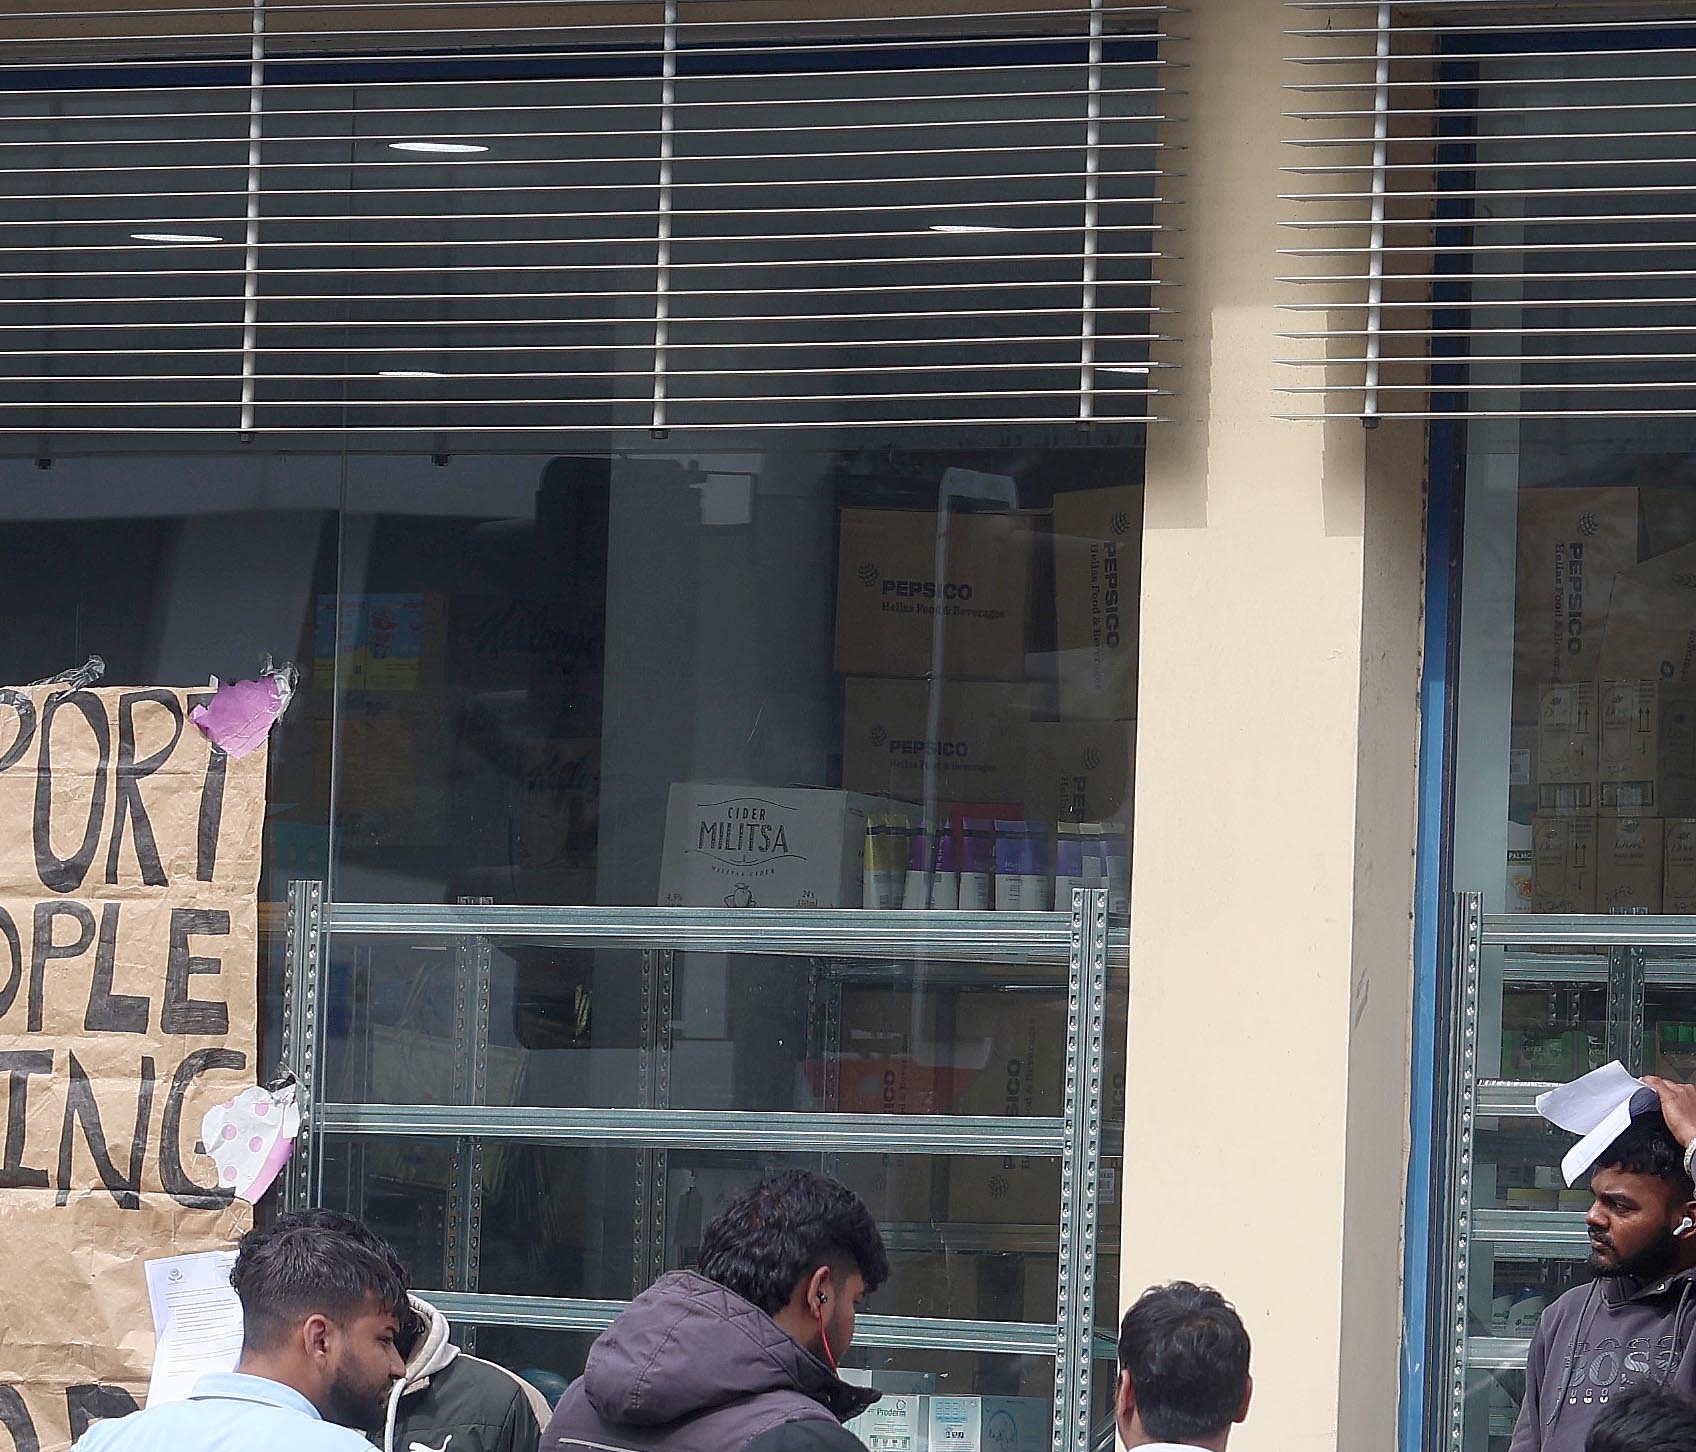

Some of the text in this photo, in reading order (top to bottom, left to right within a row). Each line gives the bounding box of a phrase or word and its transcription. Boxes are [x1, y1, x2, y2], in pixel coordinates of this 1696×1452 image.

[881, 579, 973, 601] PEPSICO
[1103, 541, 1121, 649] PEPSICO
[1567, 542, 1583, 656] PEPSICO
[889, 740, 970, 757] PEPSICO
[728, 806, 766, 821] CIDER
[698, 820, 788, 853] MILITSA
[876, 1407, 907, 1418] Proderm
